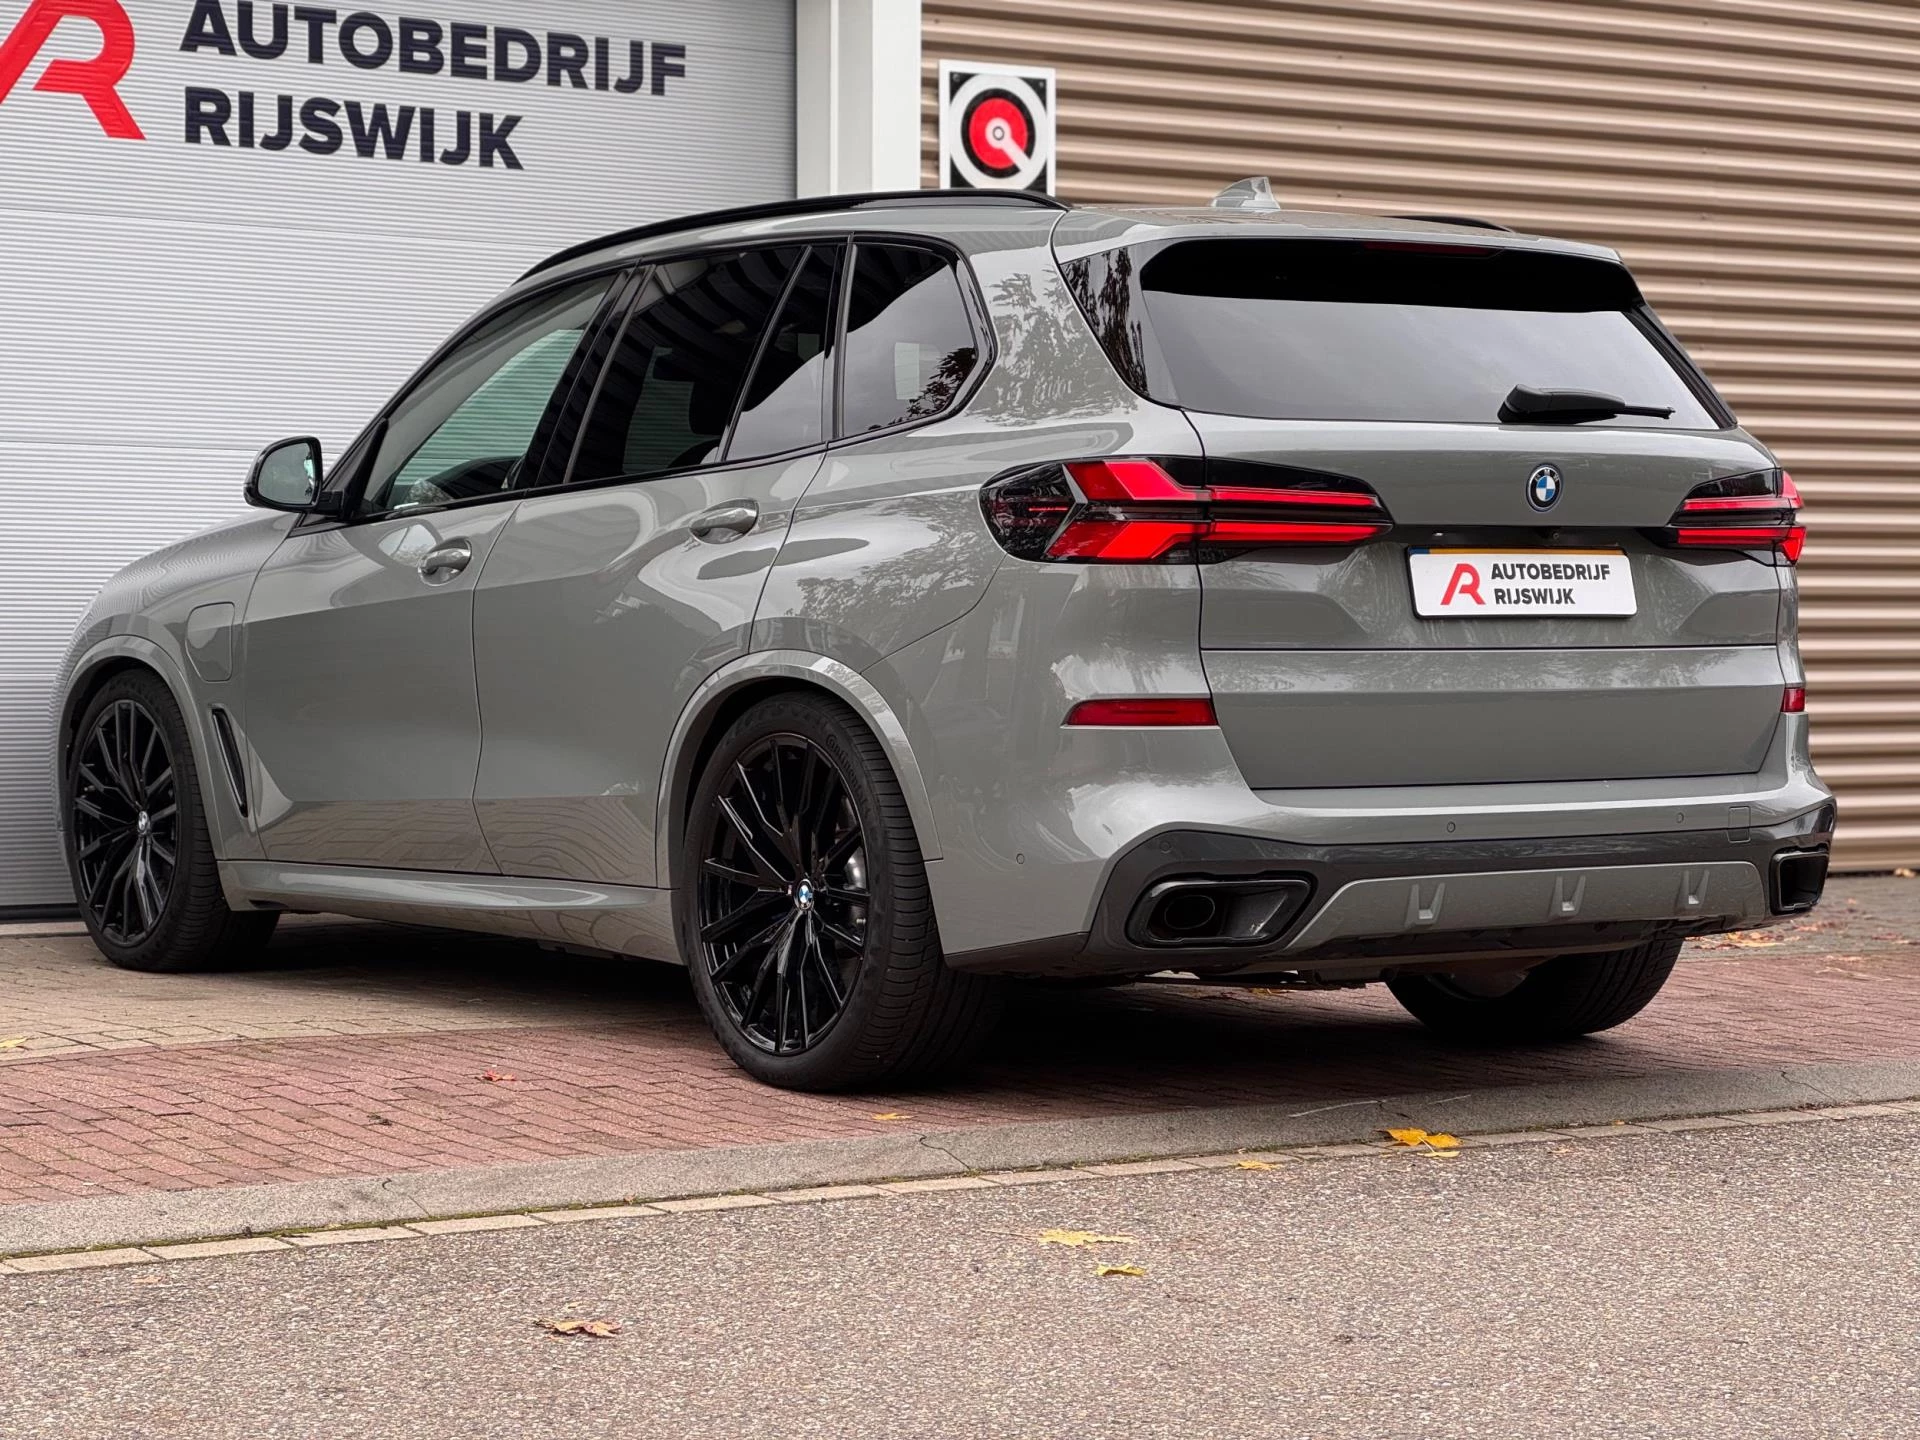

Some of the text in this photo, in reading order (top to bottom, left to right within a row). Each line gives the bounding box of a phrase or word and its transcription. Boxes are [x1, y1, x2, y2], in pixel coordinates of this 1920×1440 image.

[179, 0, 687, 97] AUTOBEDRIJF
[184, 86, 525, 171] RIJSWIJK
[1491, 563, 1610, 581] AUTOBEDRIJF
[1493, 588, 1576, 605] RIJSWIJK
